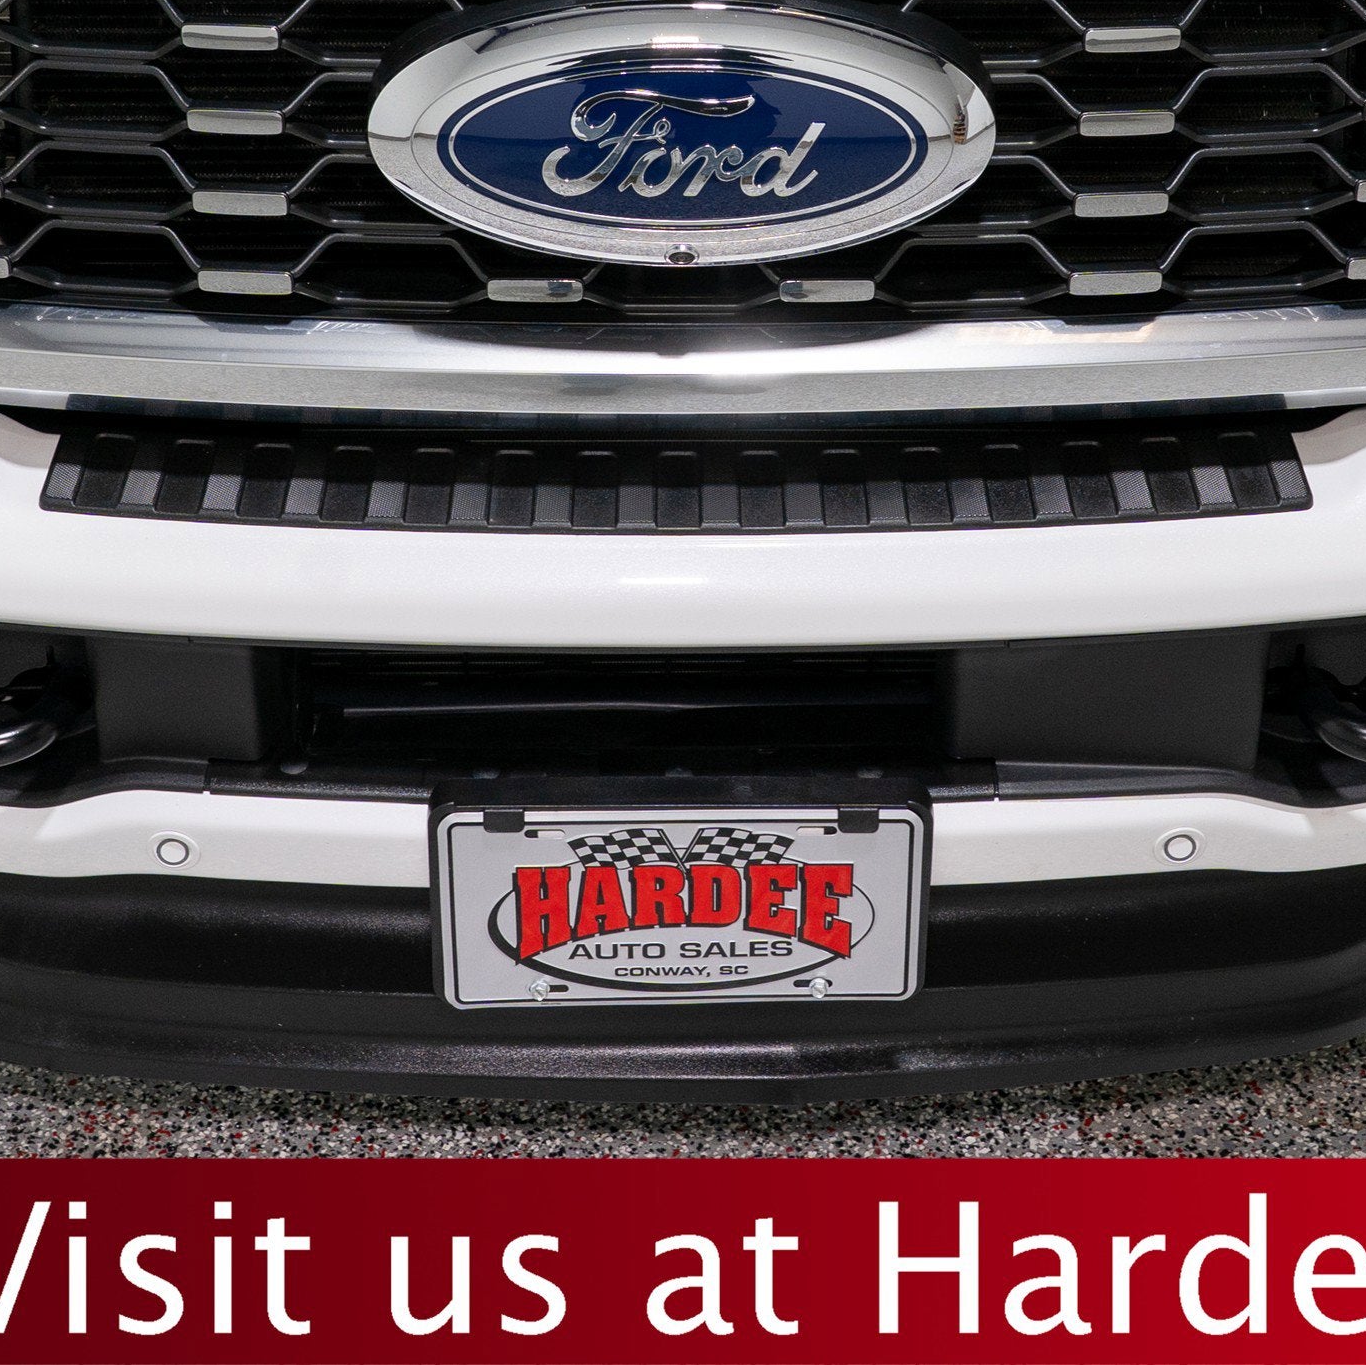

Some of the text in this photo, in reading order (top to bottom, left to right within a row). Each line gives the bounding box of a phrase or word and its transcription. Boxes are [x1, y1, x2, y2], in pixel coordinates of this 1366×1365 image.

[542, 90, 827, 198] Ford
[512, 863, 855, 965] HARDEE
[568, 940, 794, 961] AUTO SALES
[614, 965, 749, 978] CONWAY, SC
